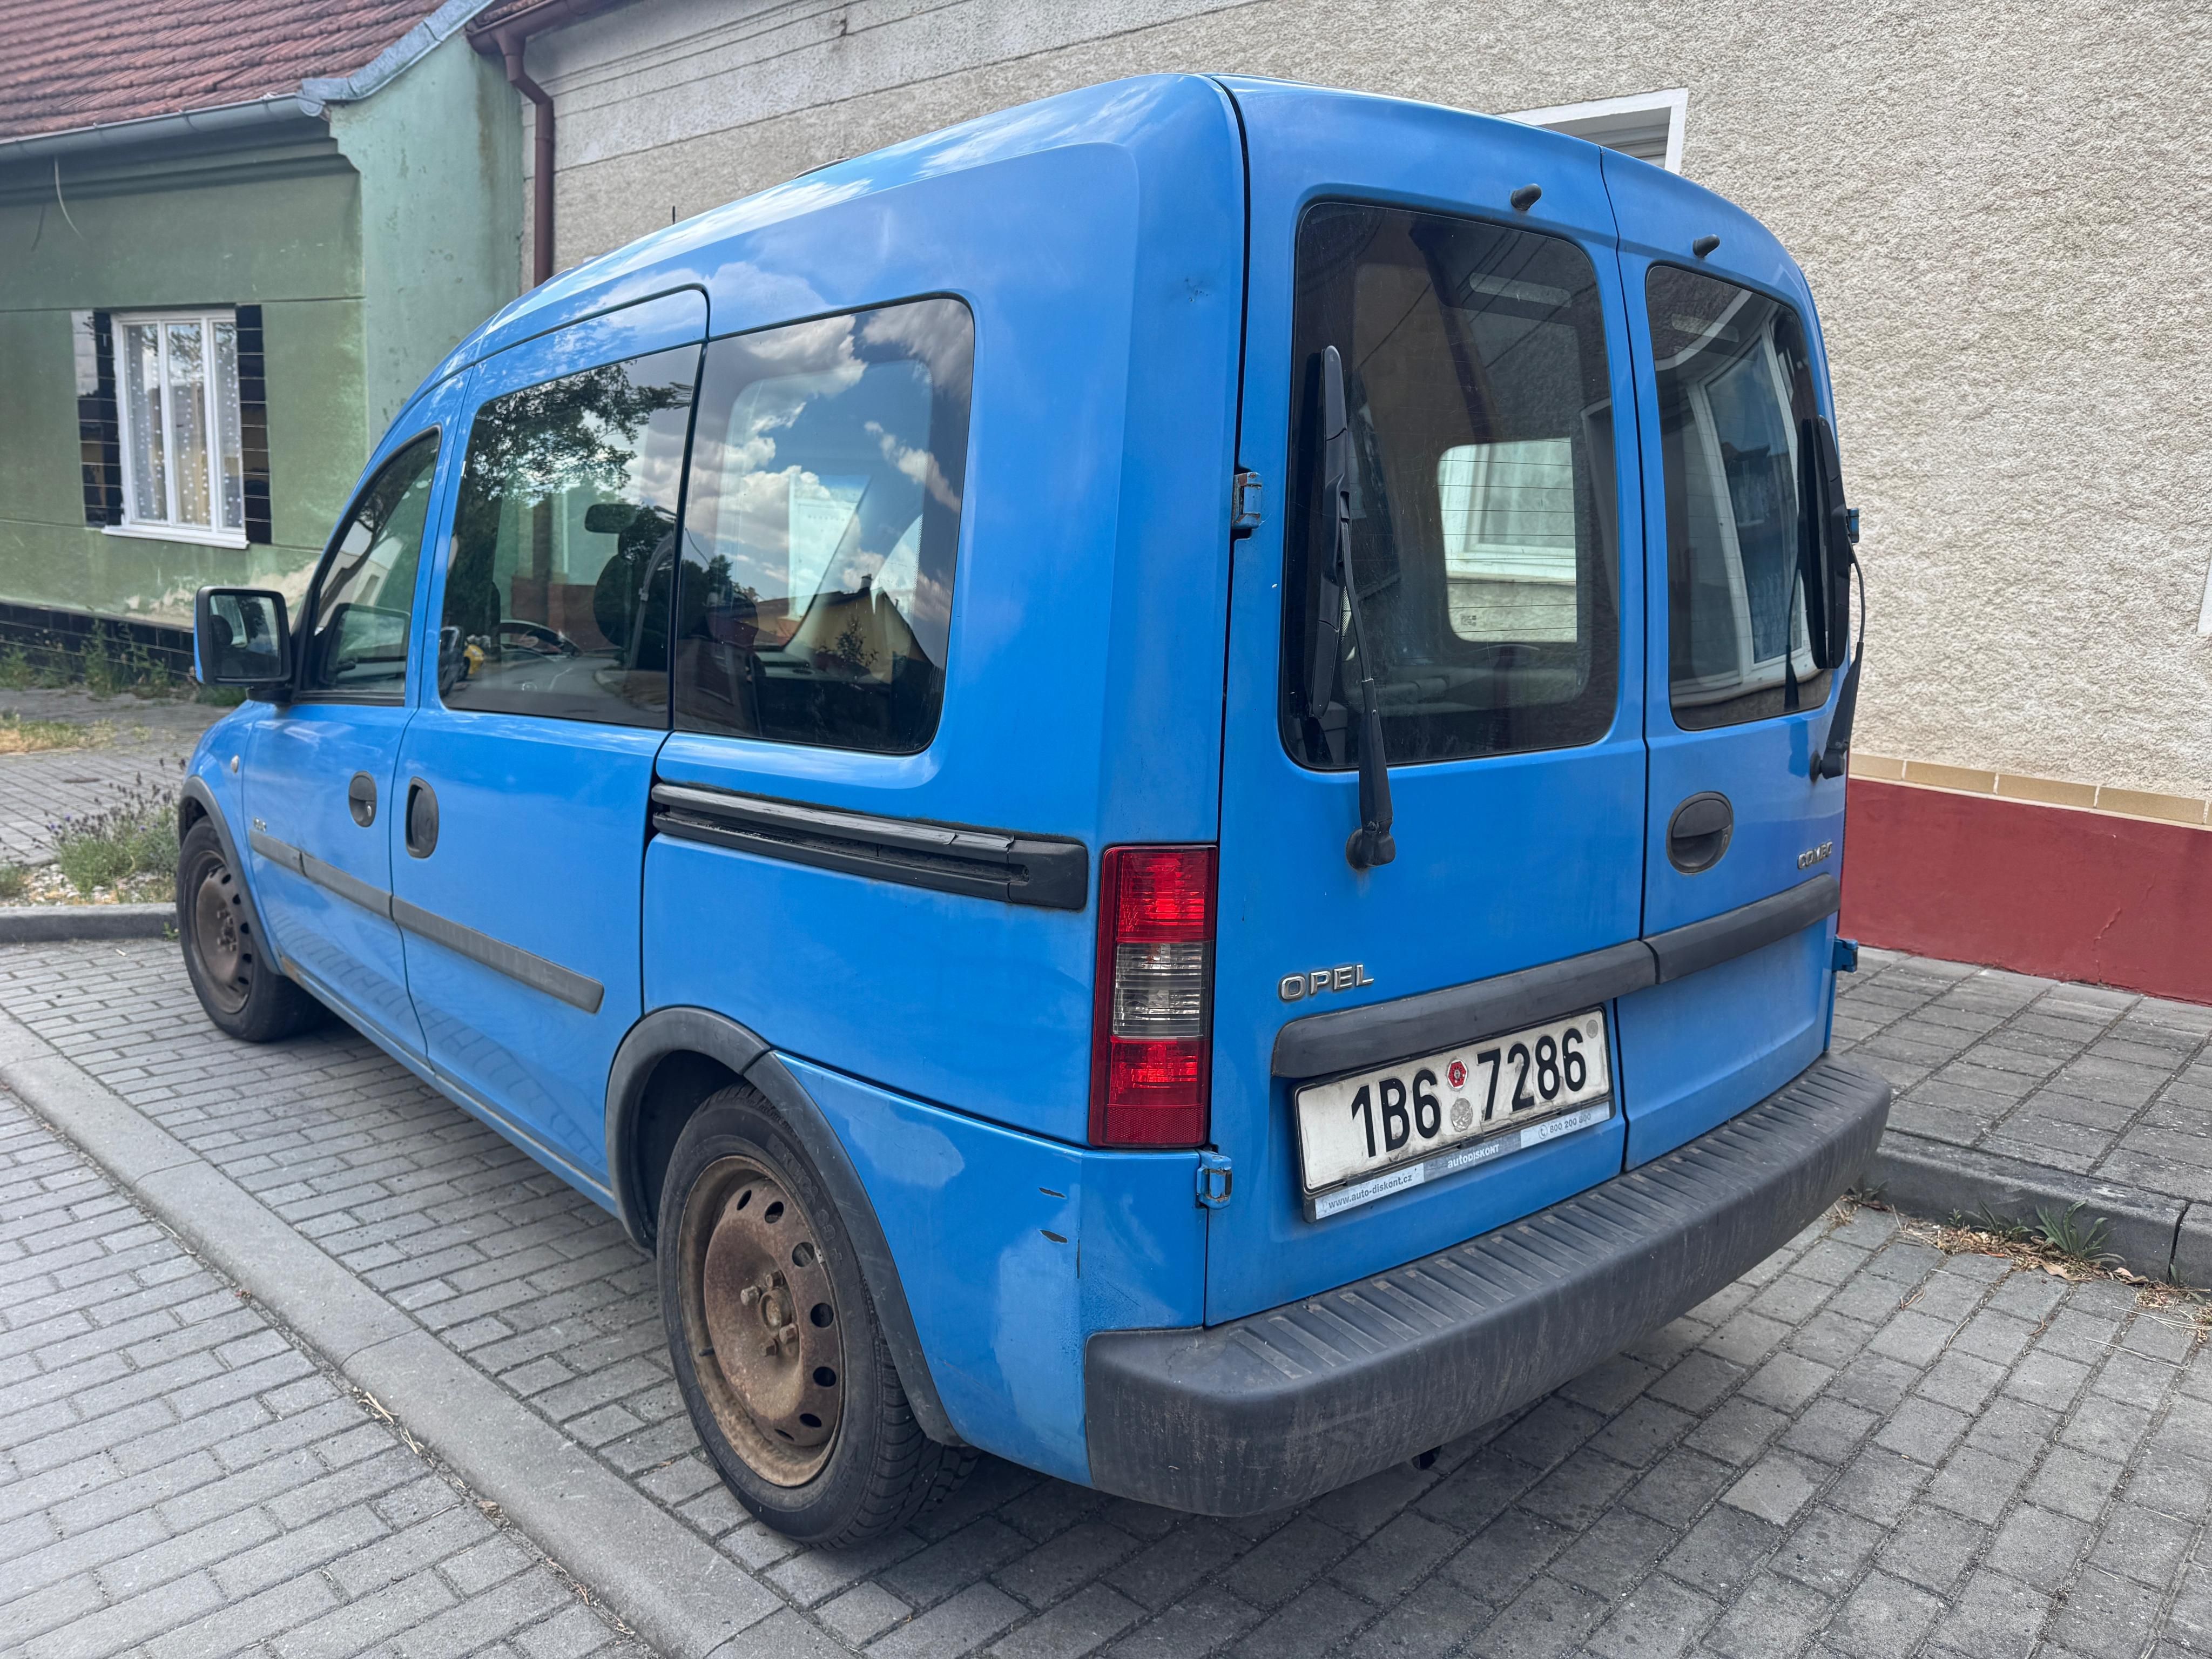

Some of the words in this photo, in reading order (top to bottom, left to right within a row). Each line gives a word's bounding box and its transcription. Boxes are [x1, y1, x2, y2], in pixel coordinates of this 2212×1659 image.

[1280, 964, 1375, 1000] OPEL
[1351, 1069, 1441, 1158] 1B6
[1477, 1028, 1587, 1122] 7286
[1549, 1122, 1563, 1134] 800
[1564, 1117, 1577, 1128] 200
[1579, 1112, 1591, 1124] 800
[1328, 1175, 1412, 1209] www.auto-diskont.cz
